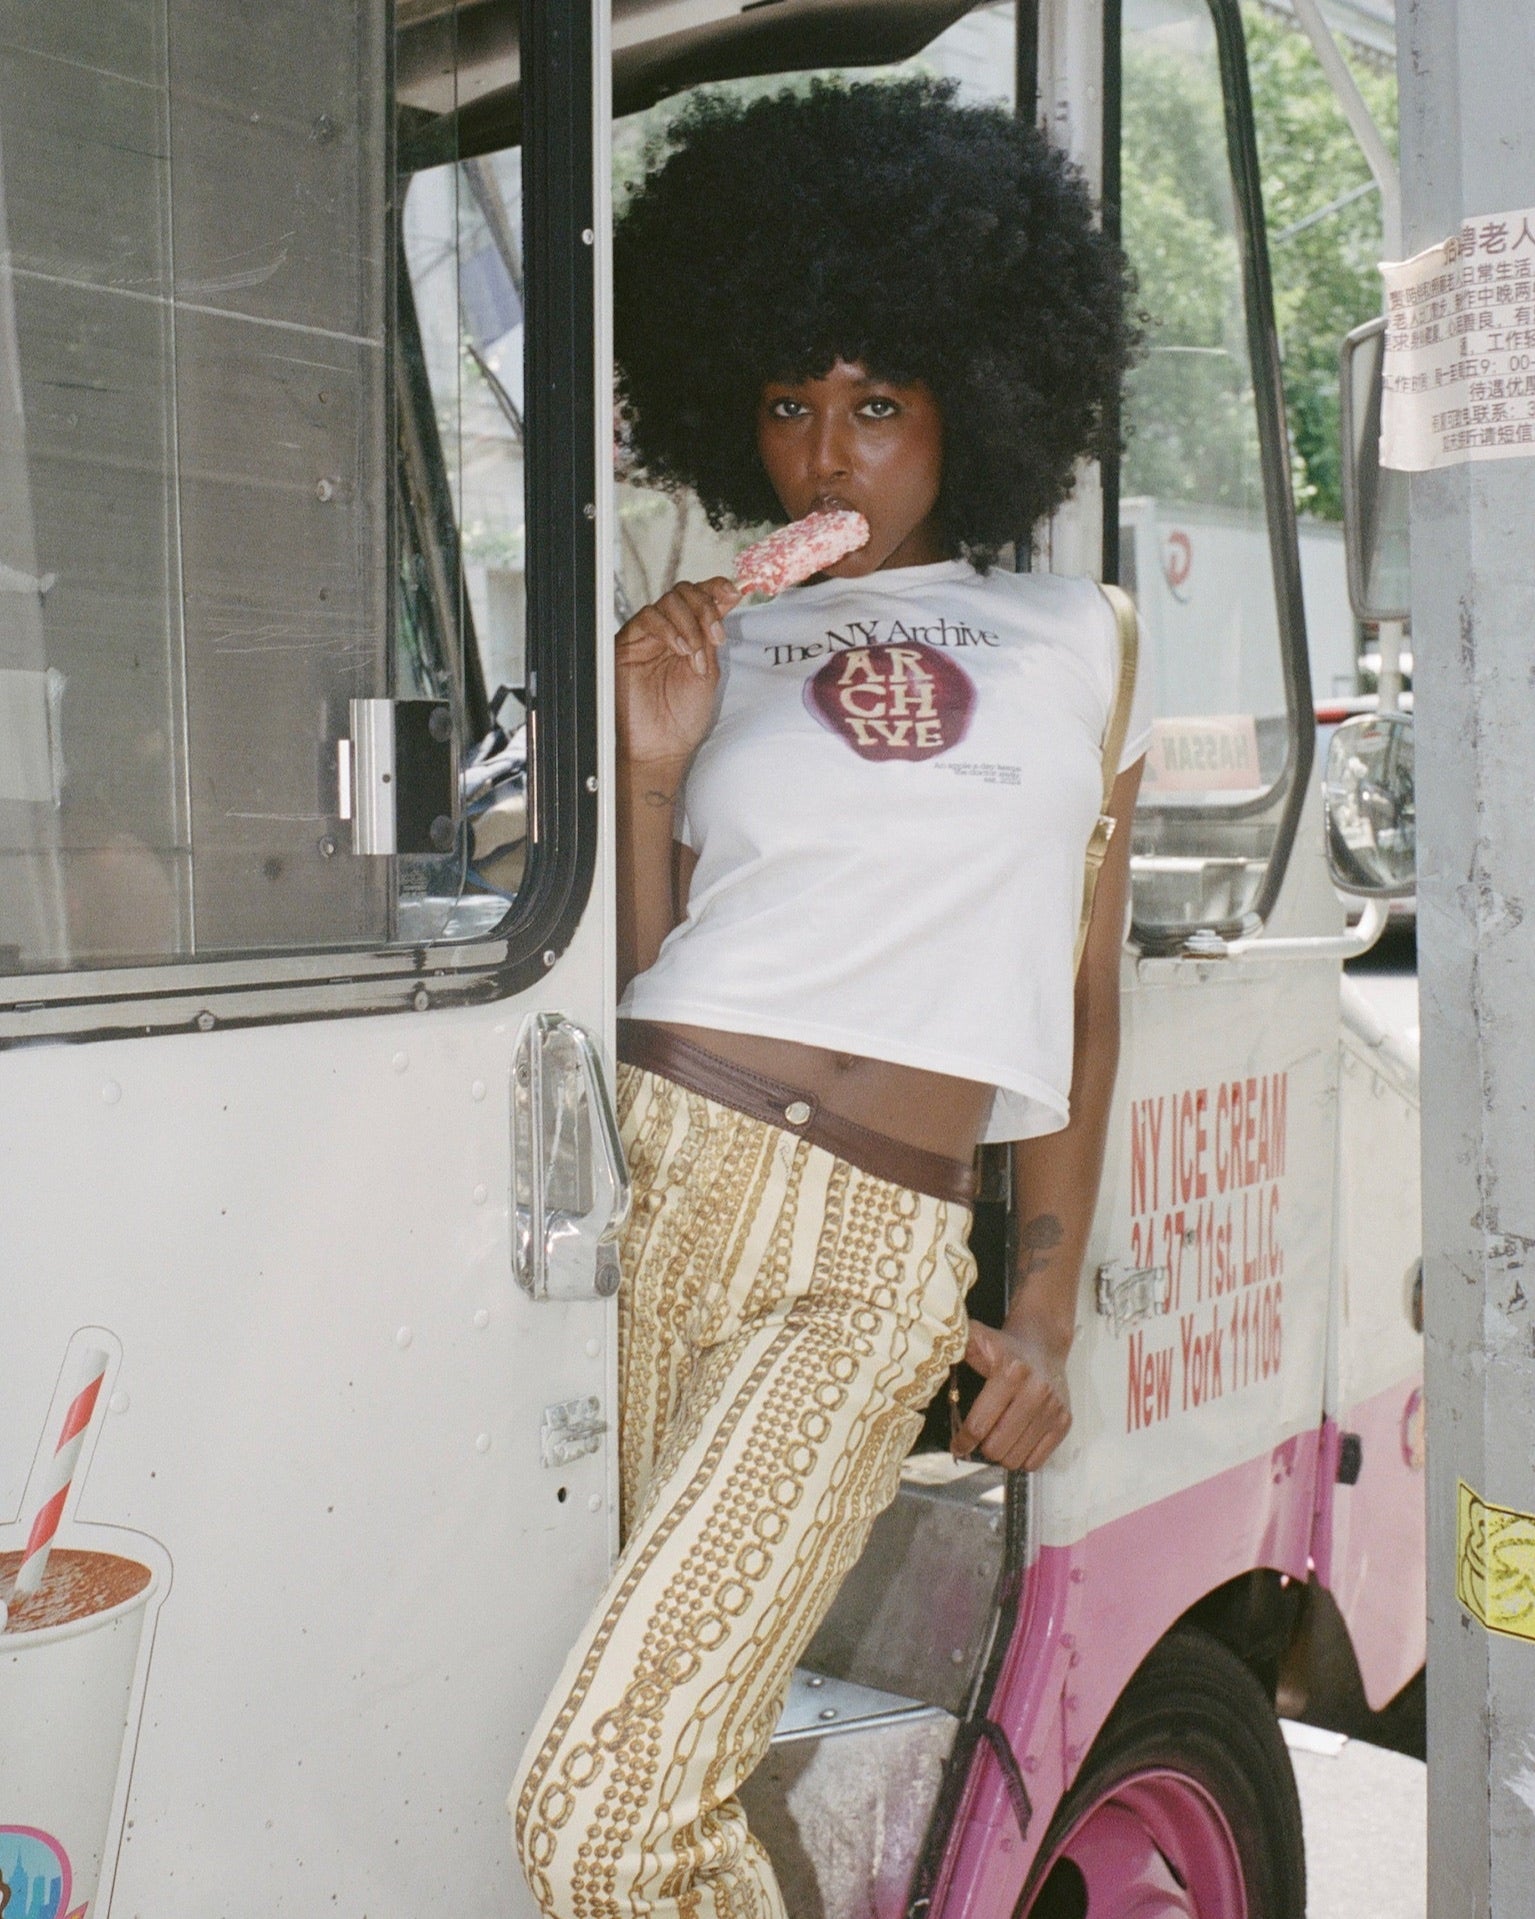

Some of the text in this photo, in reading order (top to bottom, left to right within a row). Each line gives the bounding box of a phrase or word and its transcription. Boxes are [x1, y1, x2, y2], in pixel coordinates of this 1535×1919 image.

[764, 618, 1000, 666] The NY Archive
[837, 647, 934, 685] AR
[839, 683, 938, 718] CH
[1130, 1071, 1288, 1217] NY ICE CREAM
[1126, 1280, 1283, 1434] New York 11106
